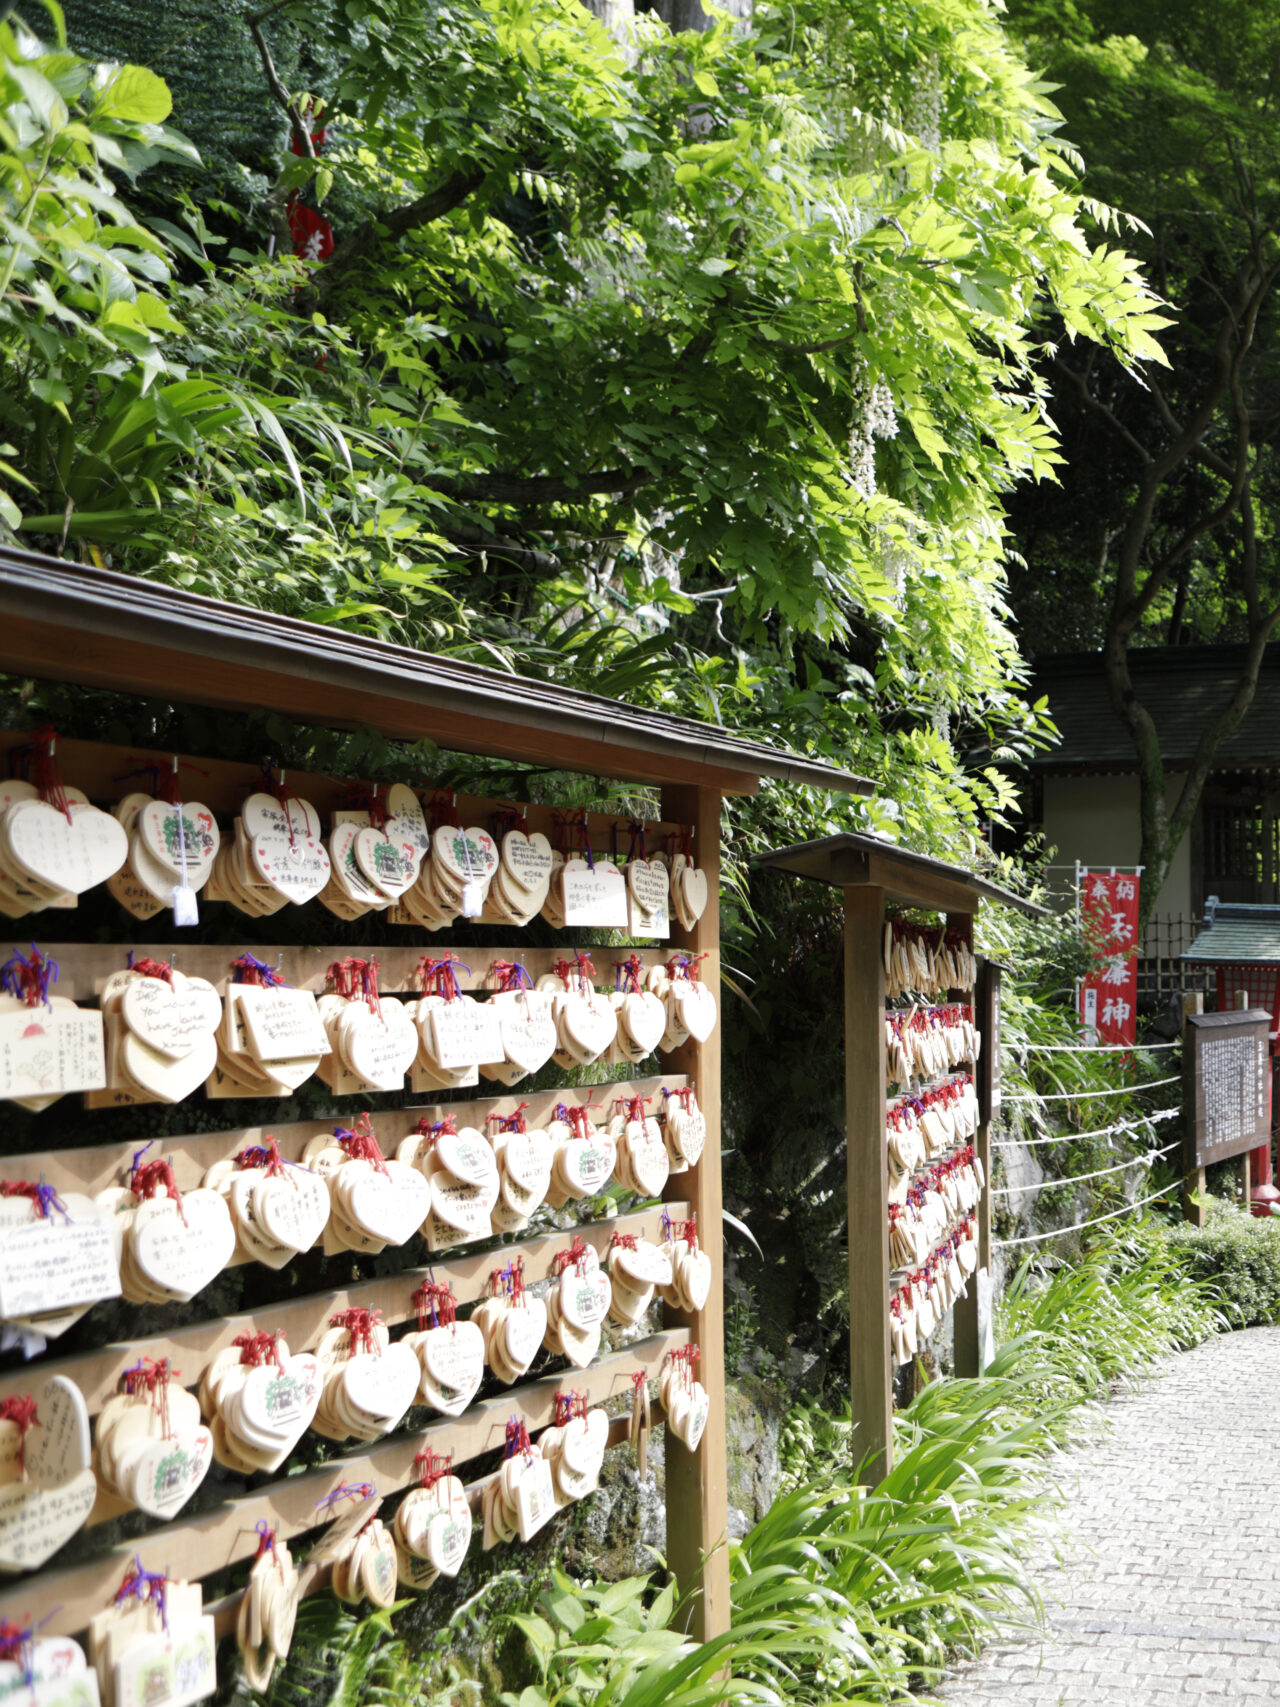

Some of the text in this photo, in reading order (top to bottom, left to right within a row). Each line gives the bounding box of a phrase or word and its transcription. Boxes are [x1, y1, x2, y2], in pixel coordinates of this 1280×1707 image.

[1090, 880, 1135, 901] 奉納
[1101, 911, 1134, 1047] 玉簾神
